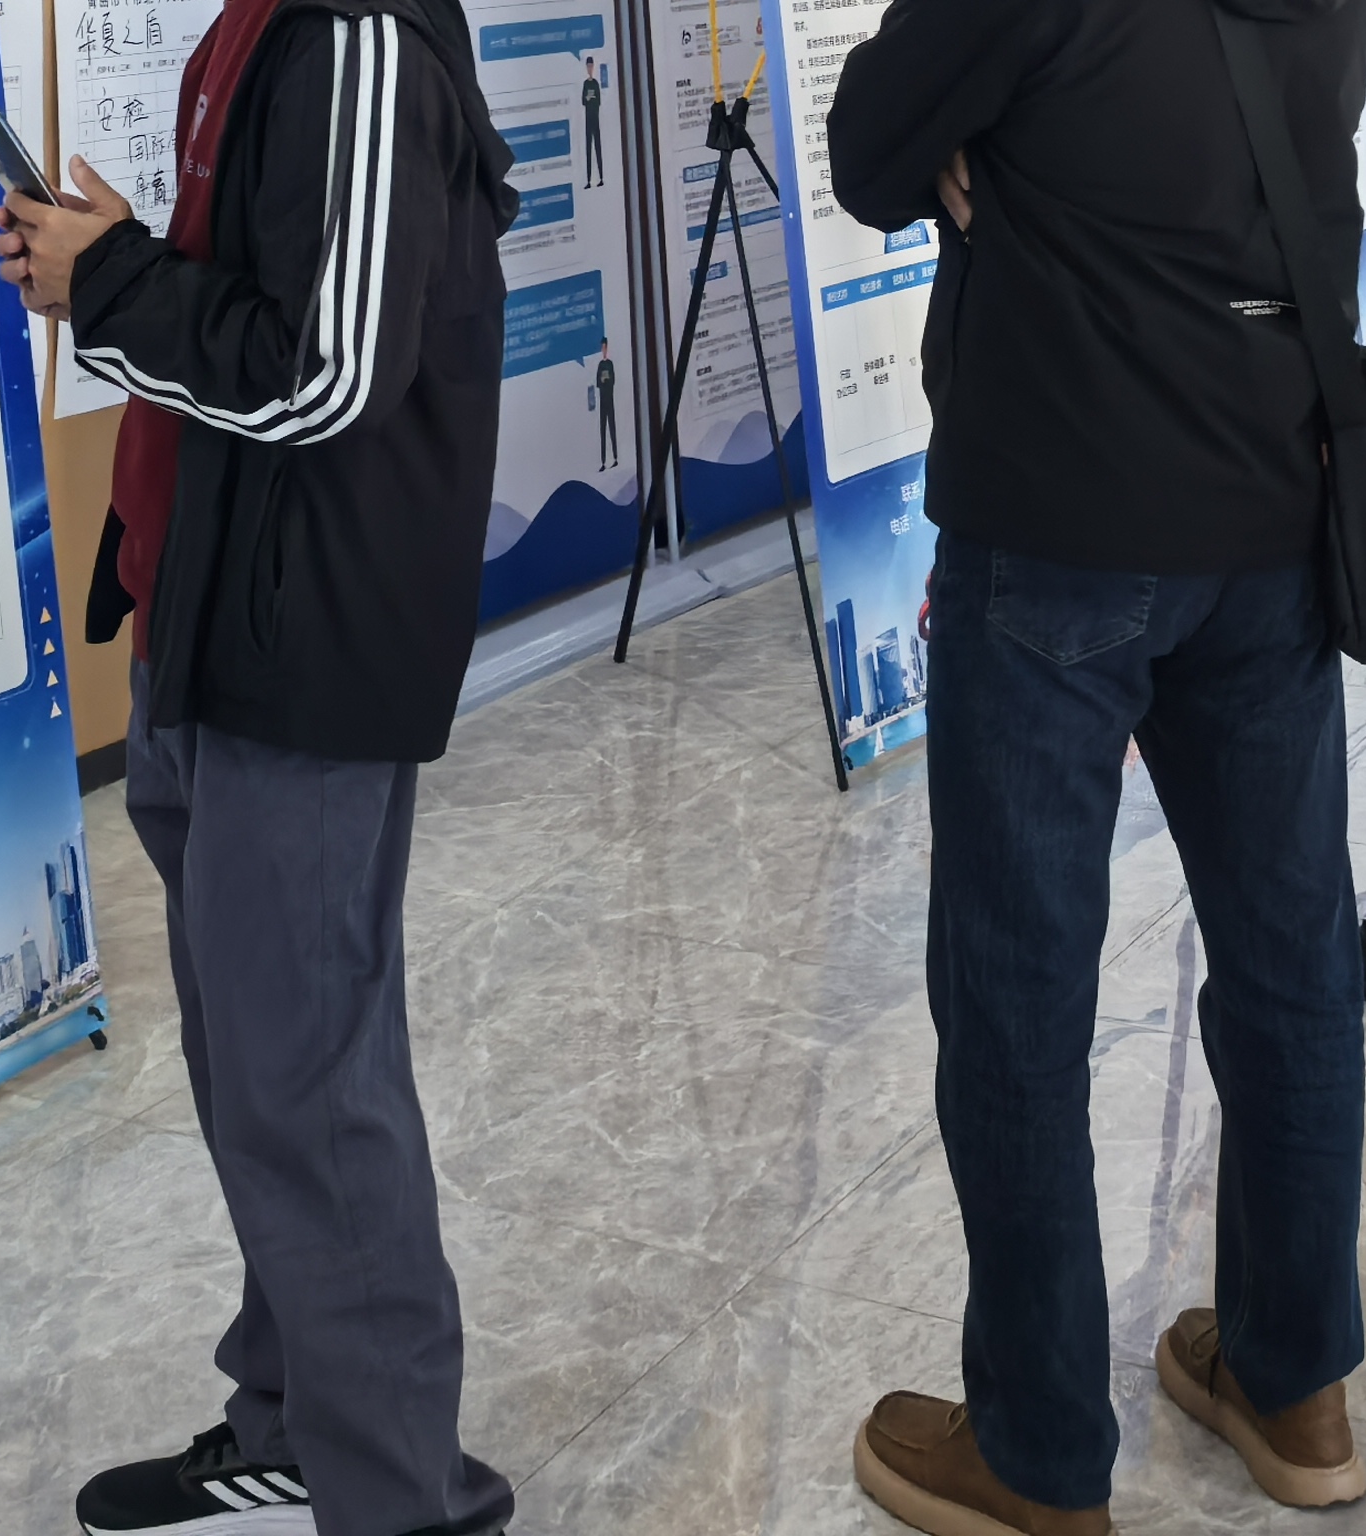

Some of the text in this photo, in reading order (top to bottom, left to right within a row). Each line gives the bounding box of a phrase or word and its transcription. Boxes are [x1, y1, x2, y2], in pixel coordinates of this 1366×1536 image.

[76, 8, 163, 65] 华夏之盾
[96, 86, 149, 132] 安检
